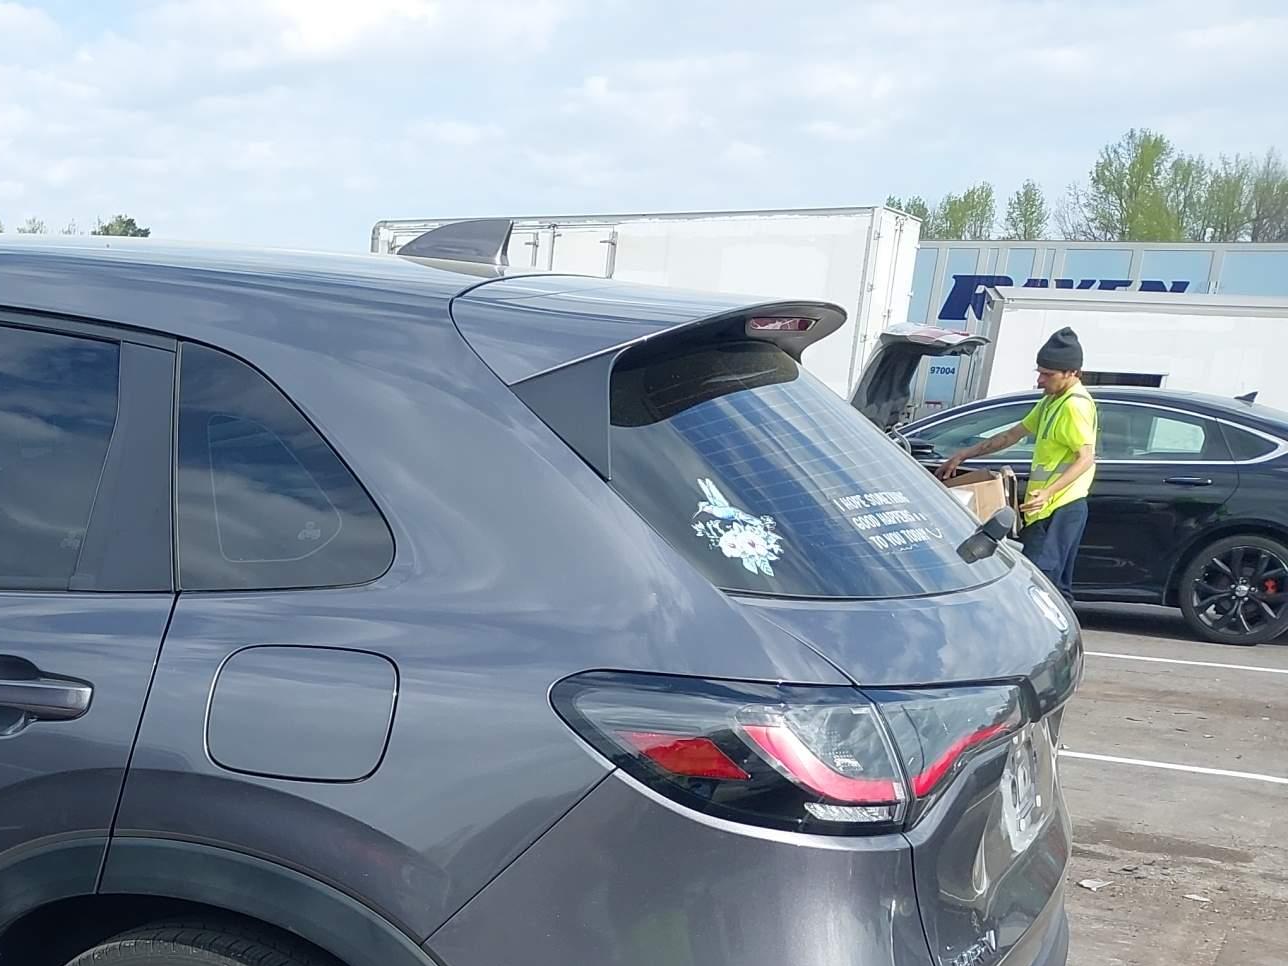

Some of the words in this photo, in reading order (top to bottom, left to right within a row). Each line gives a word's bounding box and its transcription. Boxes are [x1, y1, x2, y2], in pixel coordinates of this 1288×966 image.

[930, 366, 956, 375] 97004
[839, 493, 871, 511] HOPE
[852, 513, 882, 530] GOOD
[869, 535, 889, 550] TO
[883, 531, 908, 546] YOU
